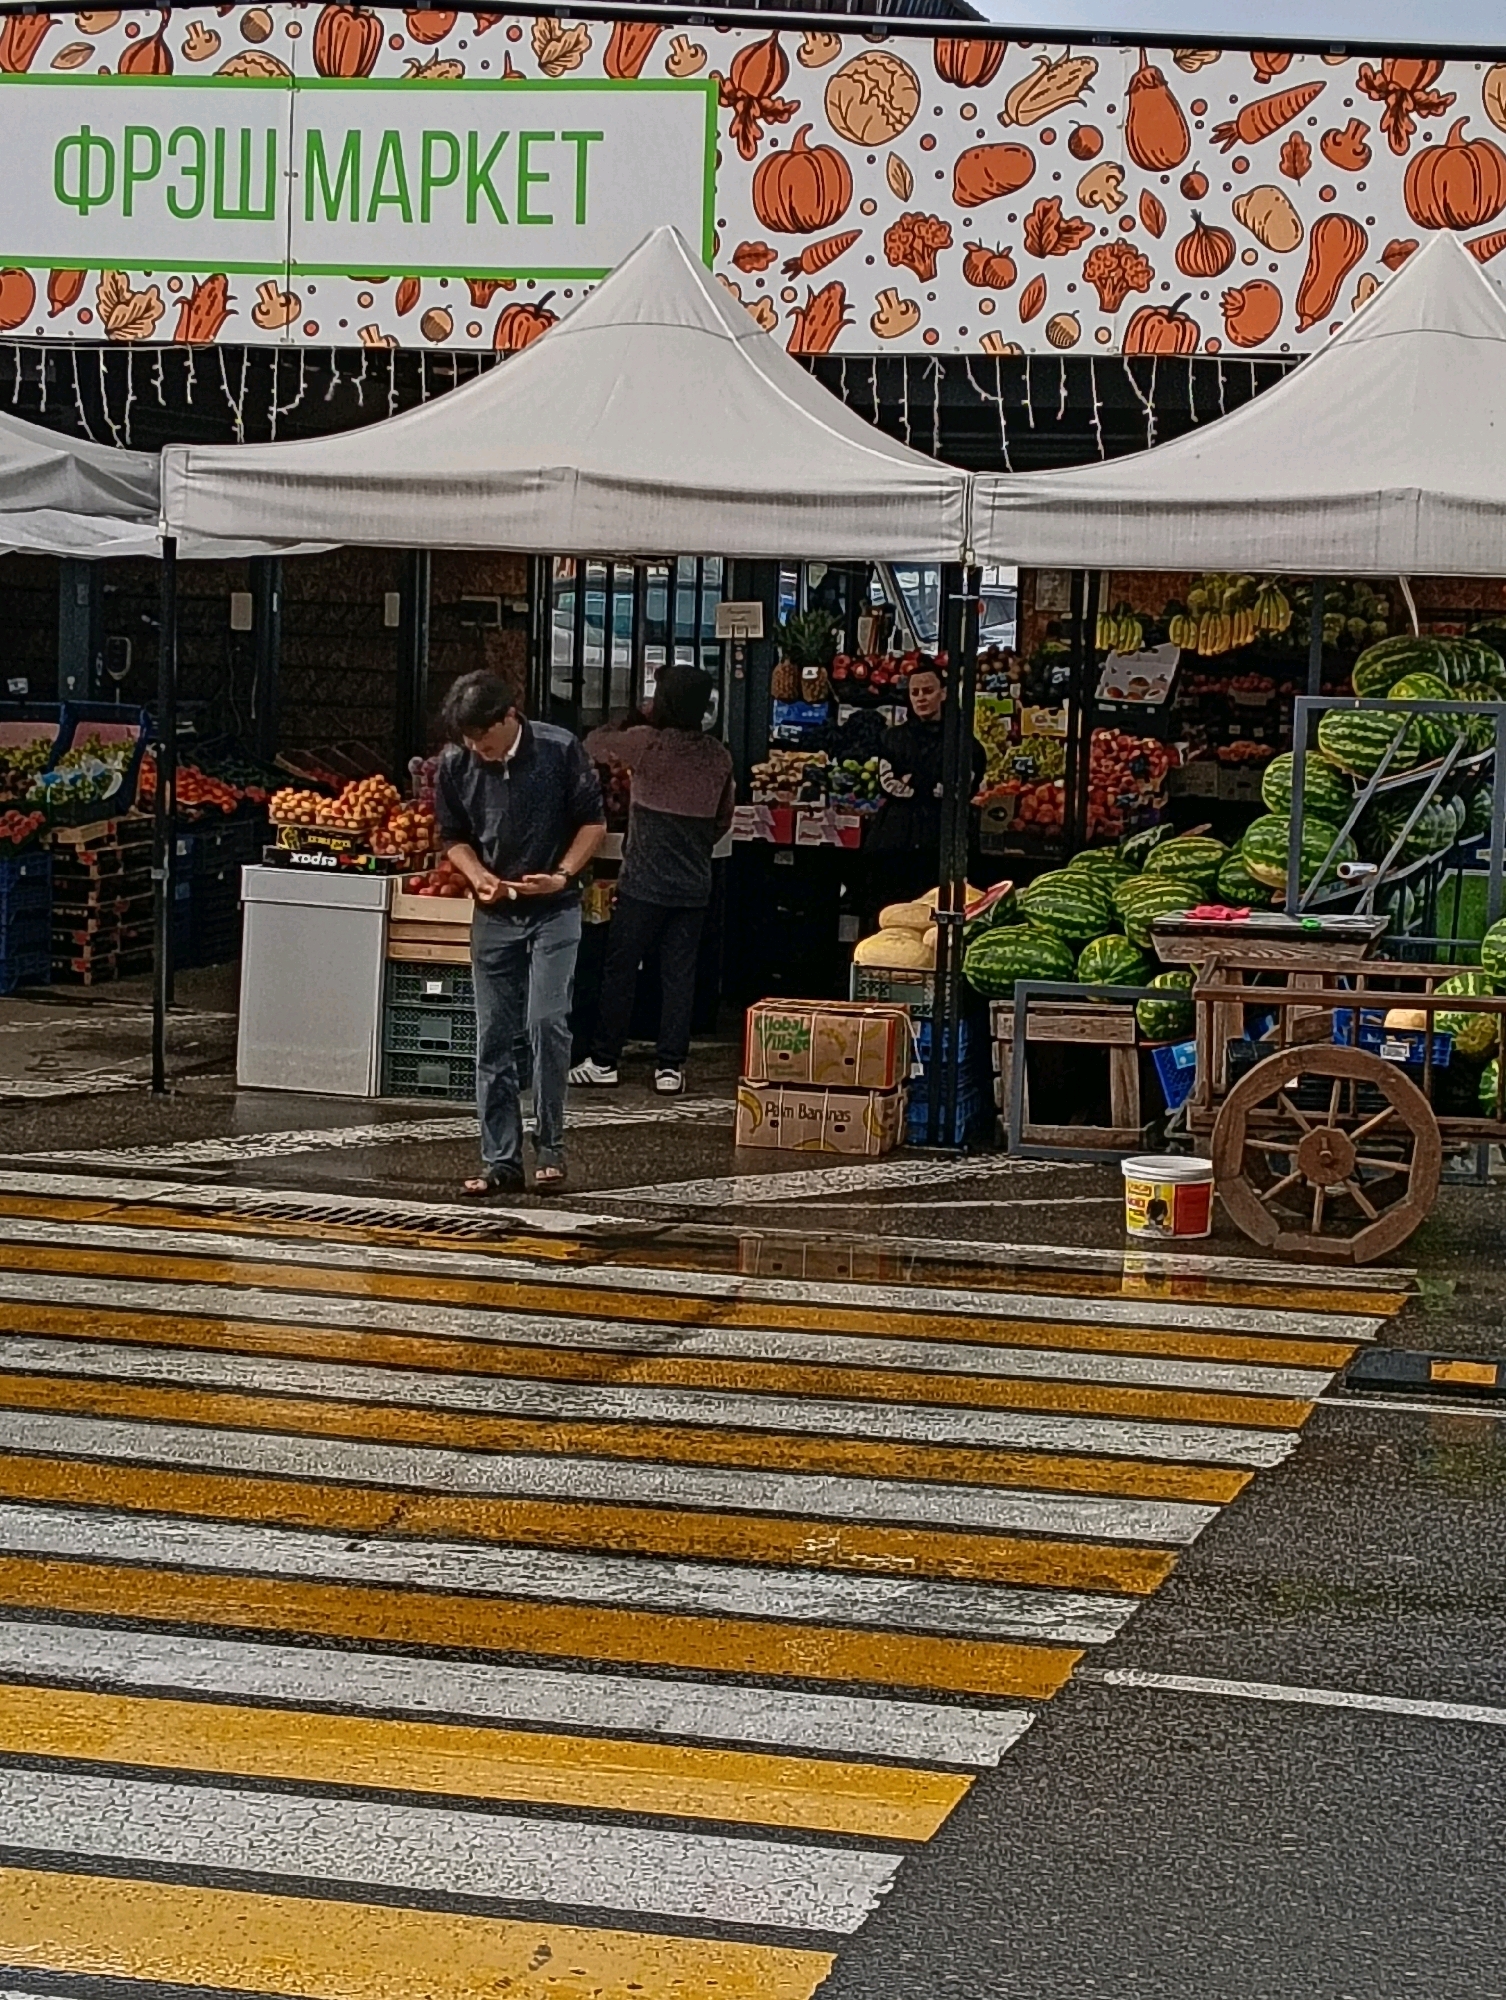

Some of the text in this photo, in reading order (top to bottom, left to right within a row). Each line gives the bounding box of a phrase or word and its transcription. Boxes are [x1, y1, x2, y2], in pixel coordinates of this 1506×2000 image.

[54, 124, 604, 225] ФРЭШ МАРКЕТ
[754, 1015, 805, 1032] Global
